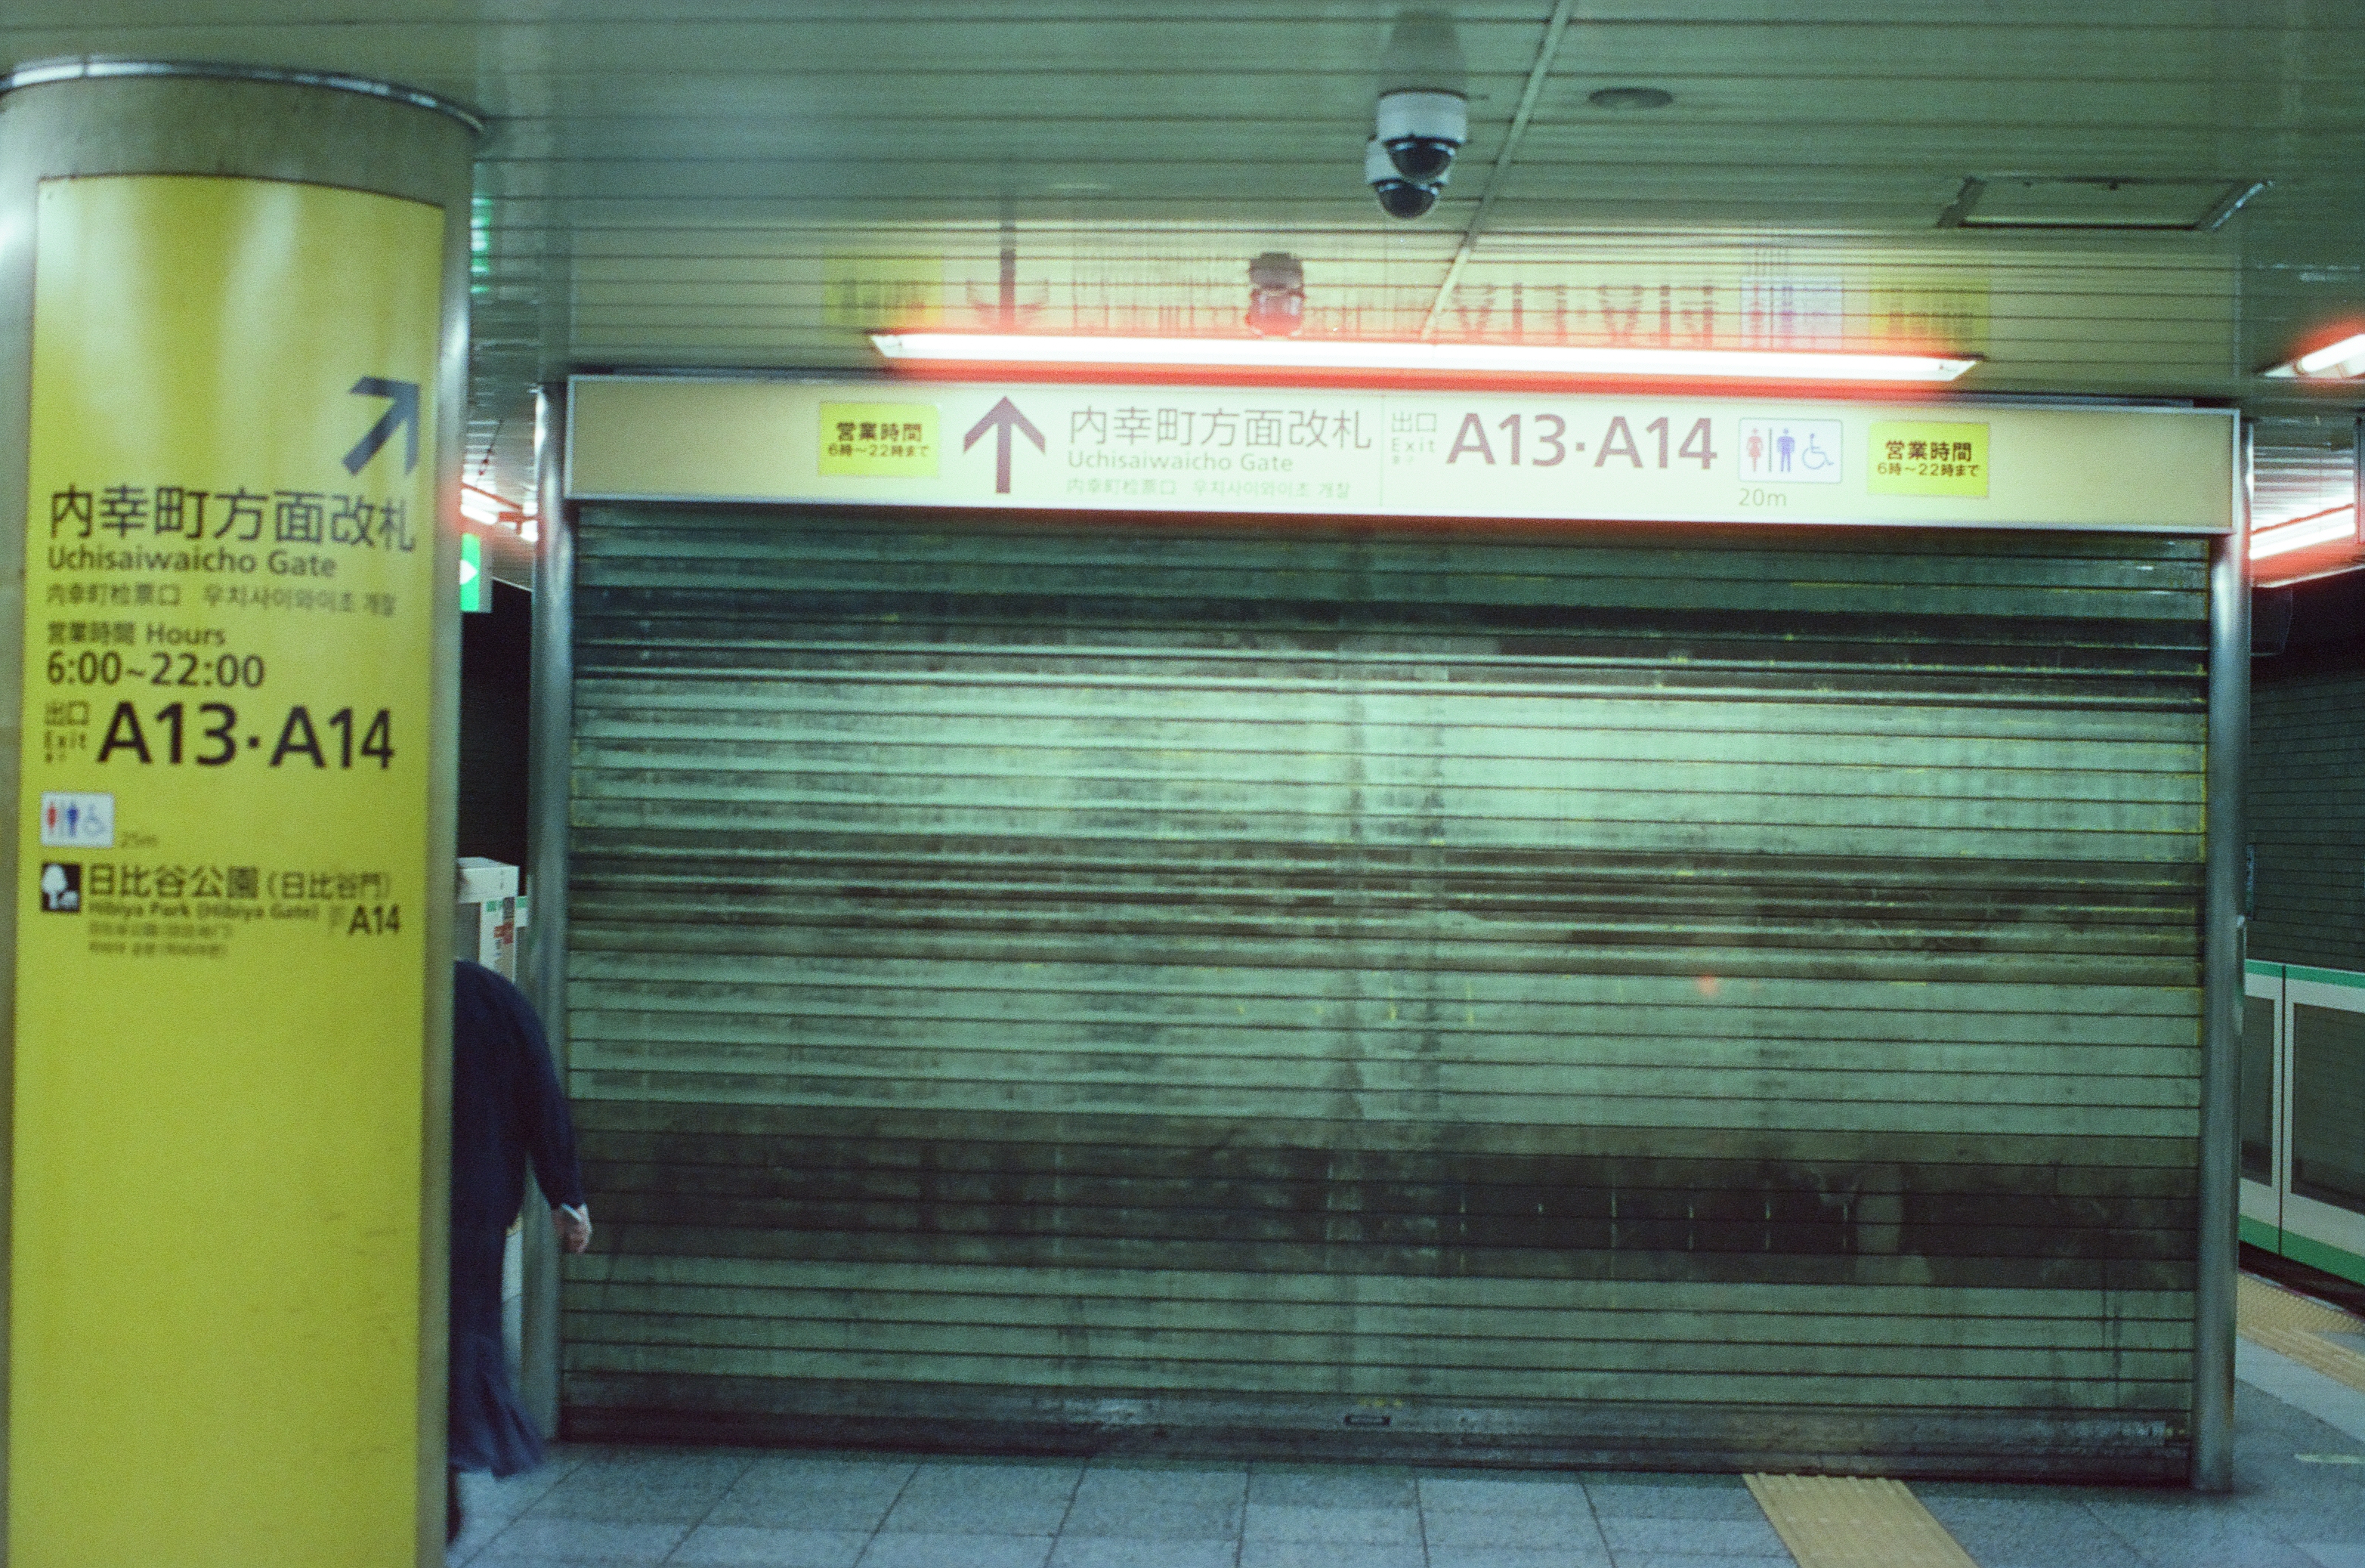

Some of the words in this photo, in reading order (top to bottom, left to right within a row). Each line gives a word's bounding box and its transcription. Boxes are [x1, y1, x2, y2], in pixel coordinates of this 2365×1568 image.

[836, 421, 923, 442] 営業時間
[1069, 406, 1372, 449] 内幸町方面改札
[1391, 412, 1436, 432] 出口
[1391, 438, 1435, 453] Exit
[1885, 440, 1972, 462] 営業時間
[1067, 450, 1232, 471] Uchisaiwaicho
[1240, 453, 1294, 472] Gate
[1739, 487, 1788, 507] 20m
[50, 484, 415, 552] 内幸町方面改札
[48, 544, 257, 574] Uchisaiwaicho
[267, 550, 338, 577] Gate
[147, 623, 227, 648] Hours
[44, 700, 90, 726] 出口
[43, 729, 88, 751] Exit
[348, 905, 401, 936] A14
